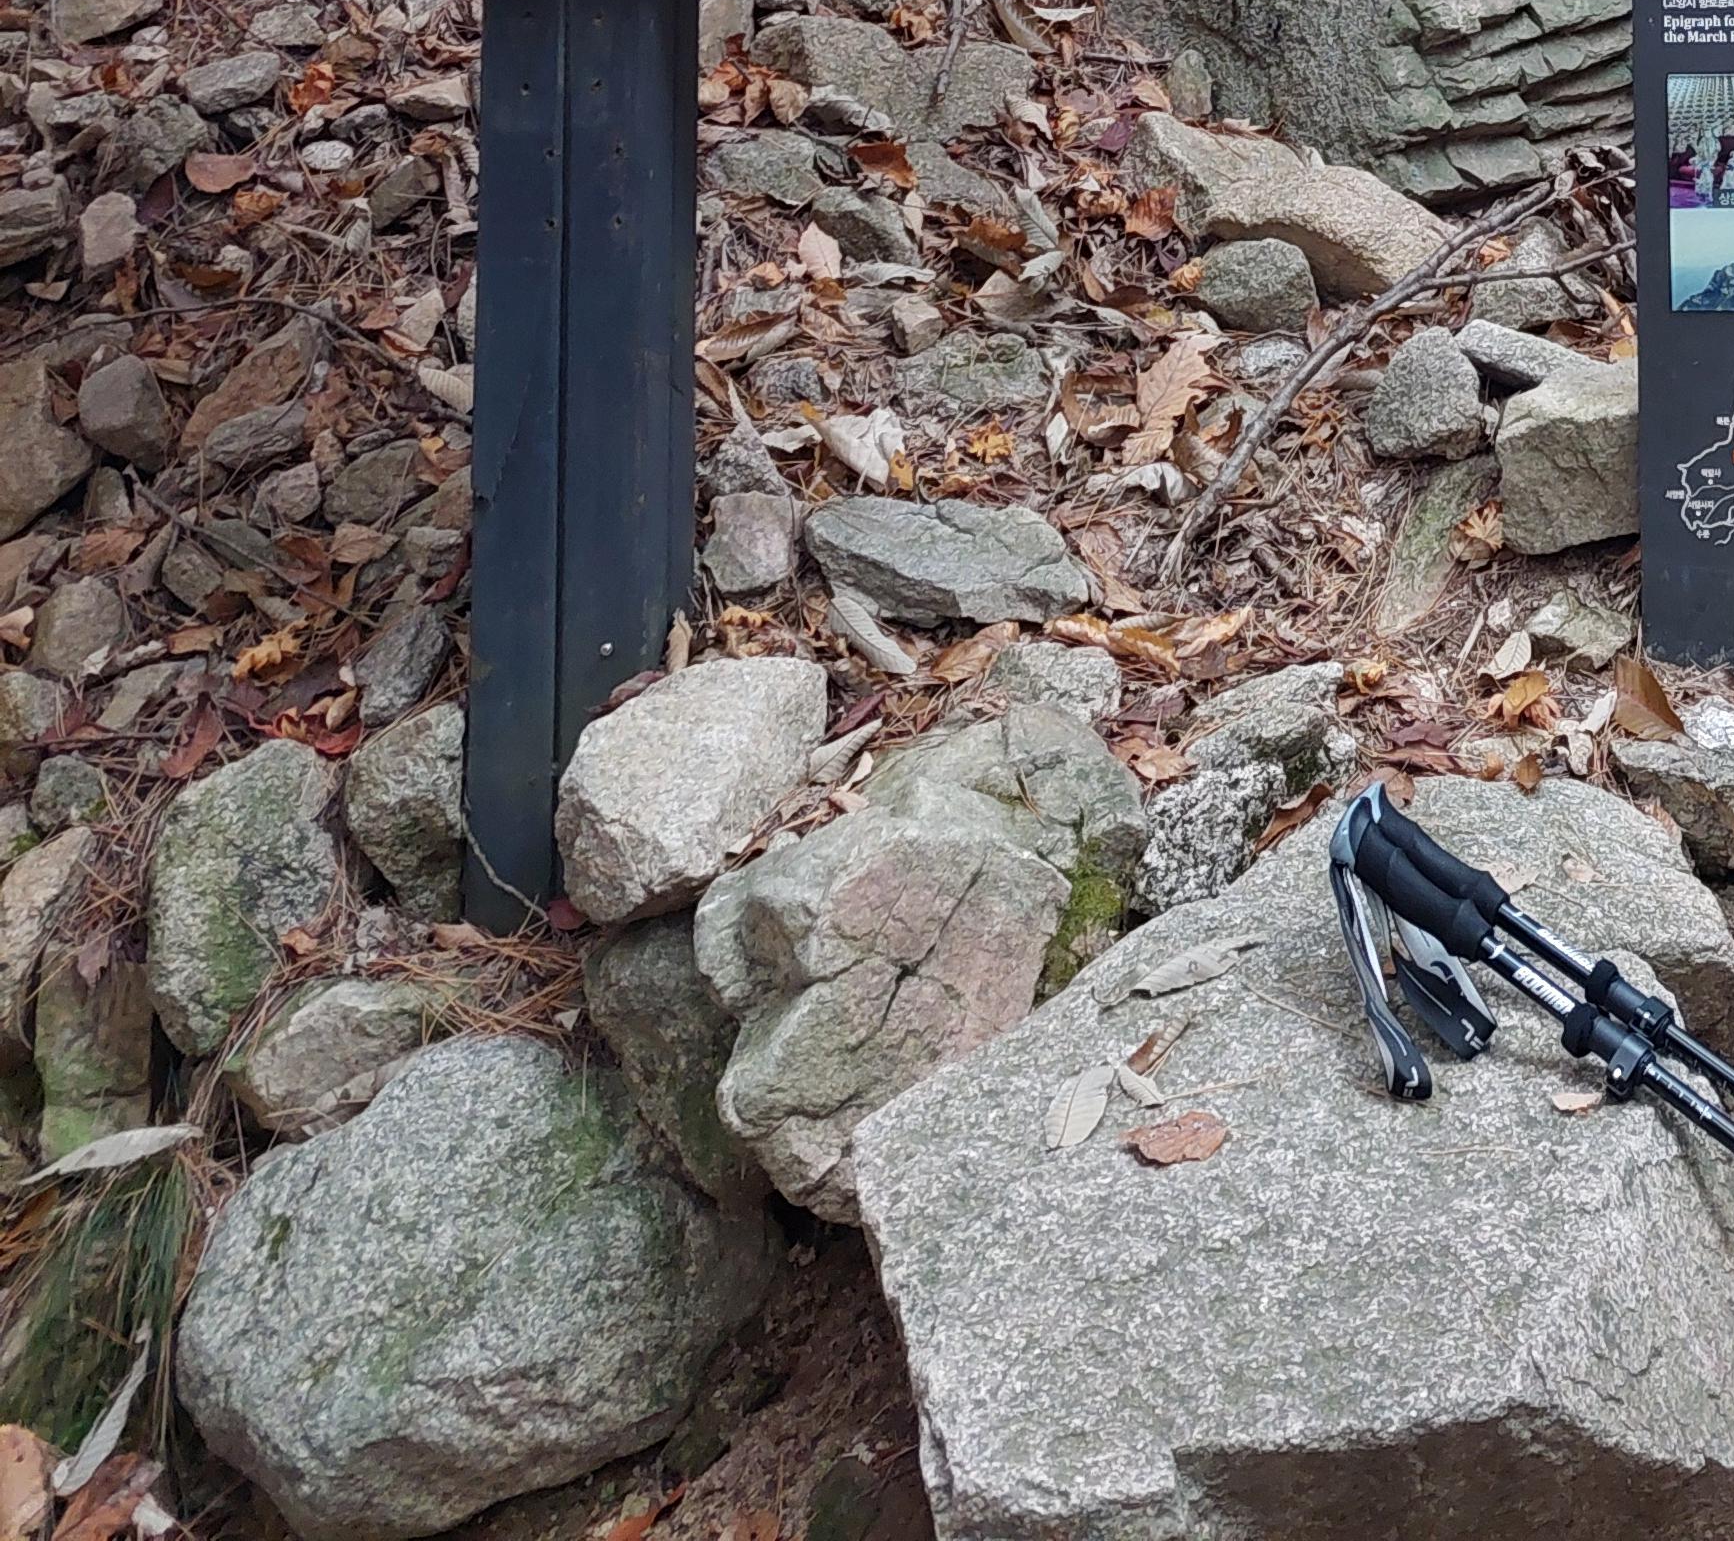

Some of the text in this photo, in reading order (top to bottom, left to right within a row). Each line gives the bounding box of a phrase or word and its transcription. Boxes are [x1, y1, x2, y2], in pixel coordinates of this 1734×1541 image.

[1664, 16, 1720, 31] Epigraph
[1664, 32, 1685, 42] the
[1688, 31, 1727, 42] March
